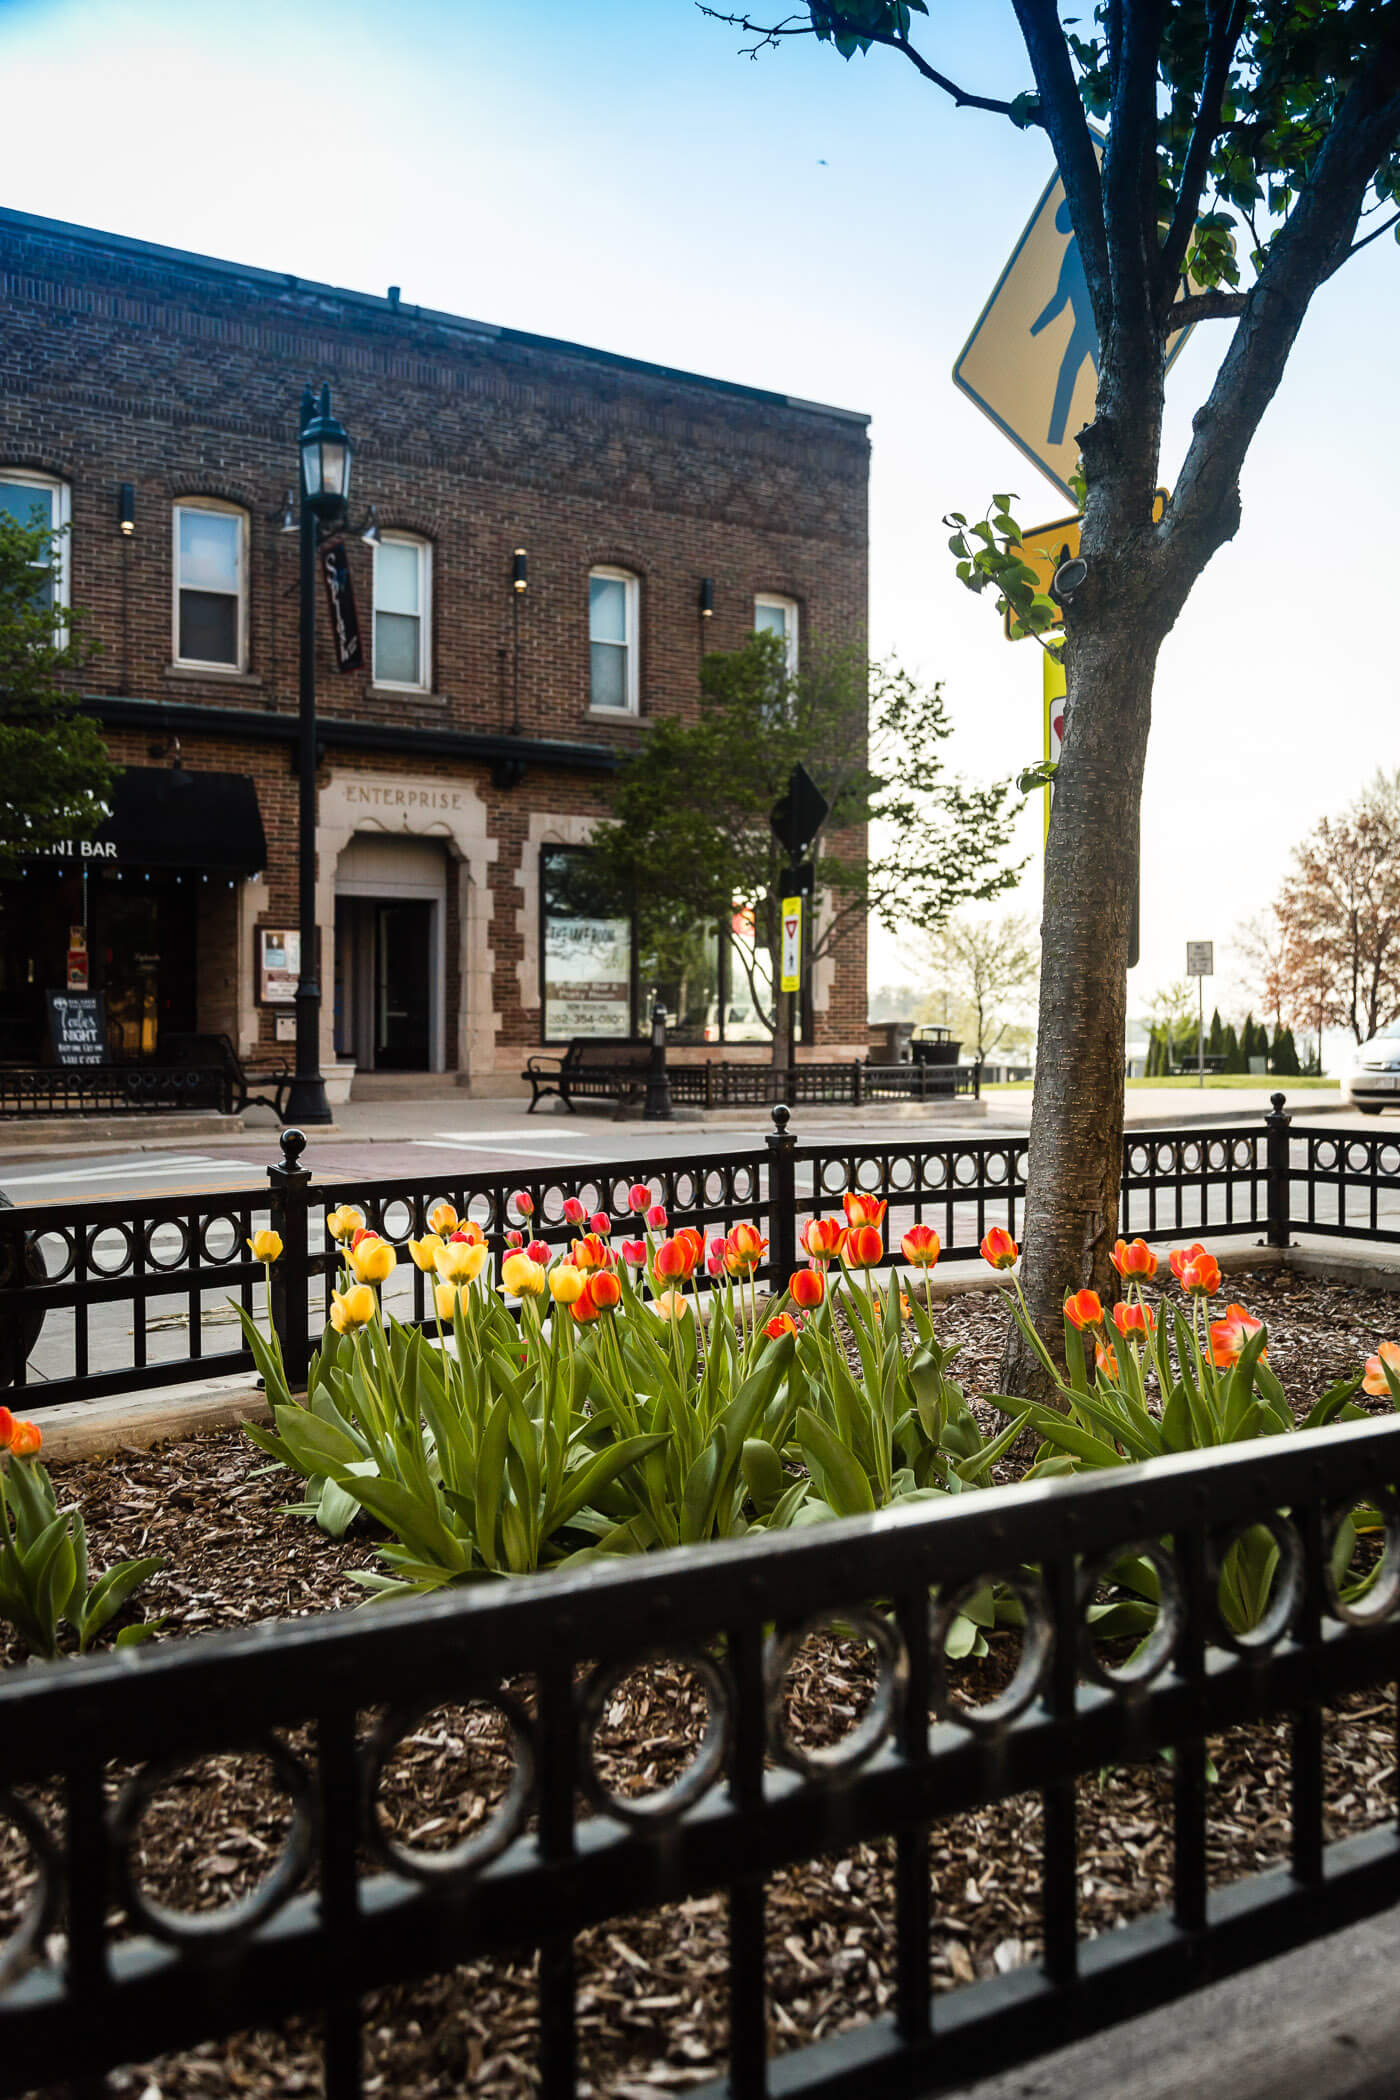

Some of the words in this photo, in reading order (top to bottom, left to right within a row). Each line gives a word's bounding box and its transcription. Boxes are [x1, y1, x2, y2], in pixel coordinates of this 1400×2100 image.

[346, 785, 462, 810] ENTERPRISE
[80, 841, 119, 858] BAR
[62, 1028, 98, 1043] NIGHT
